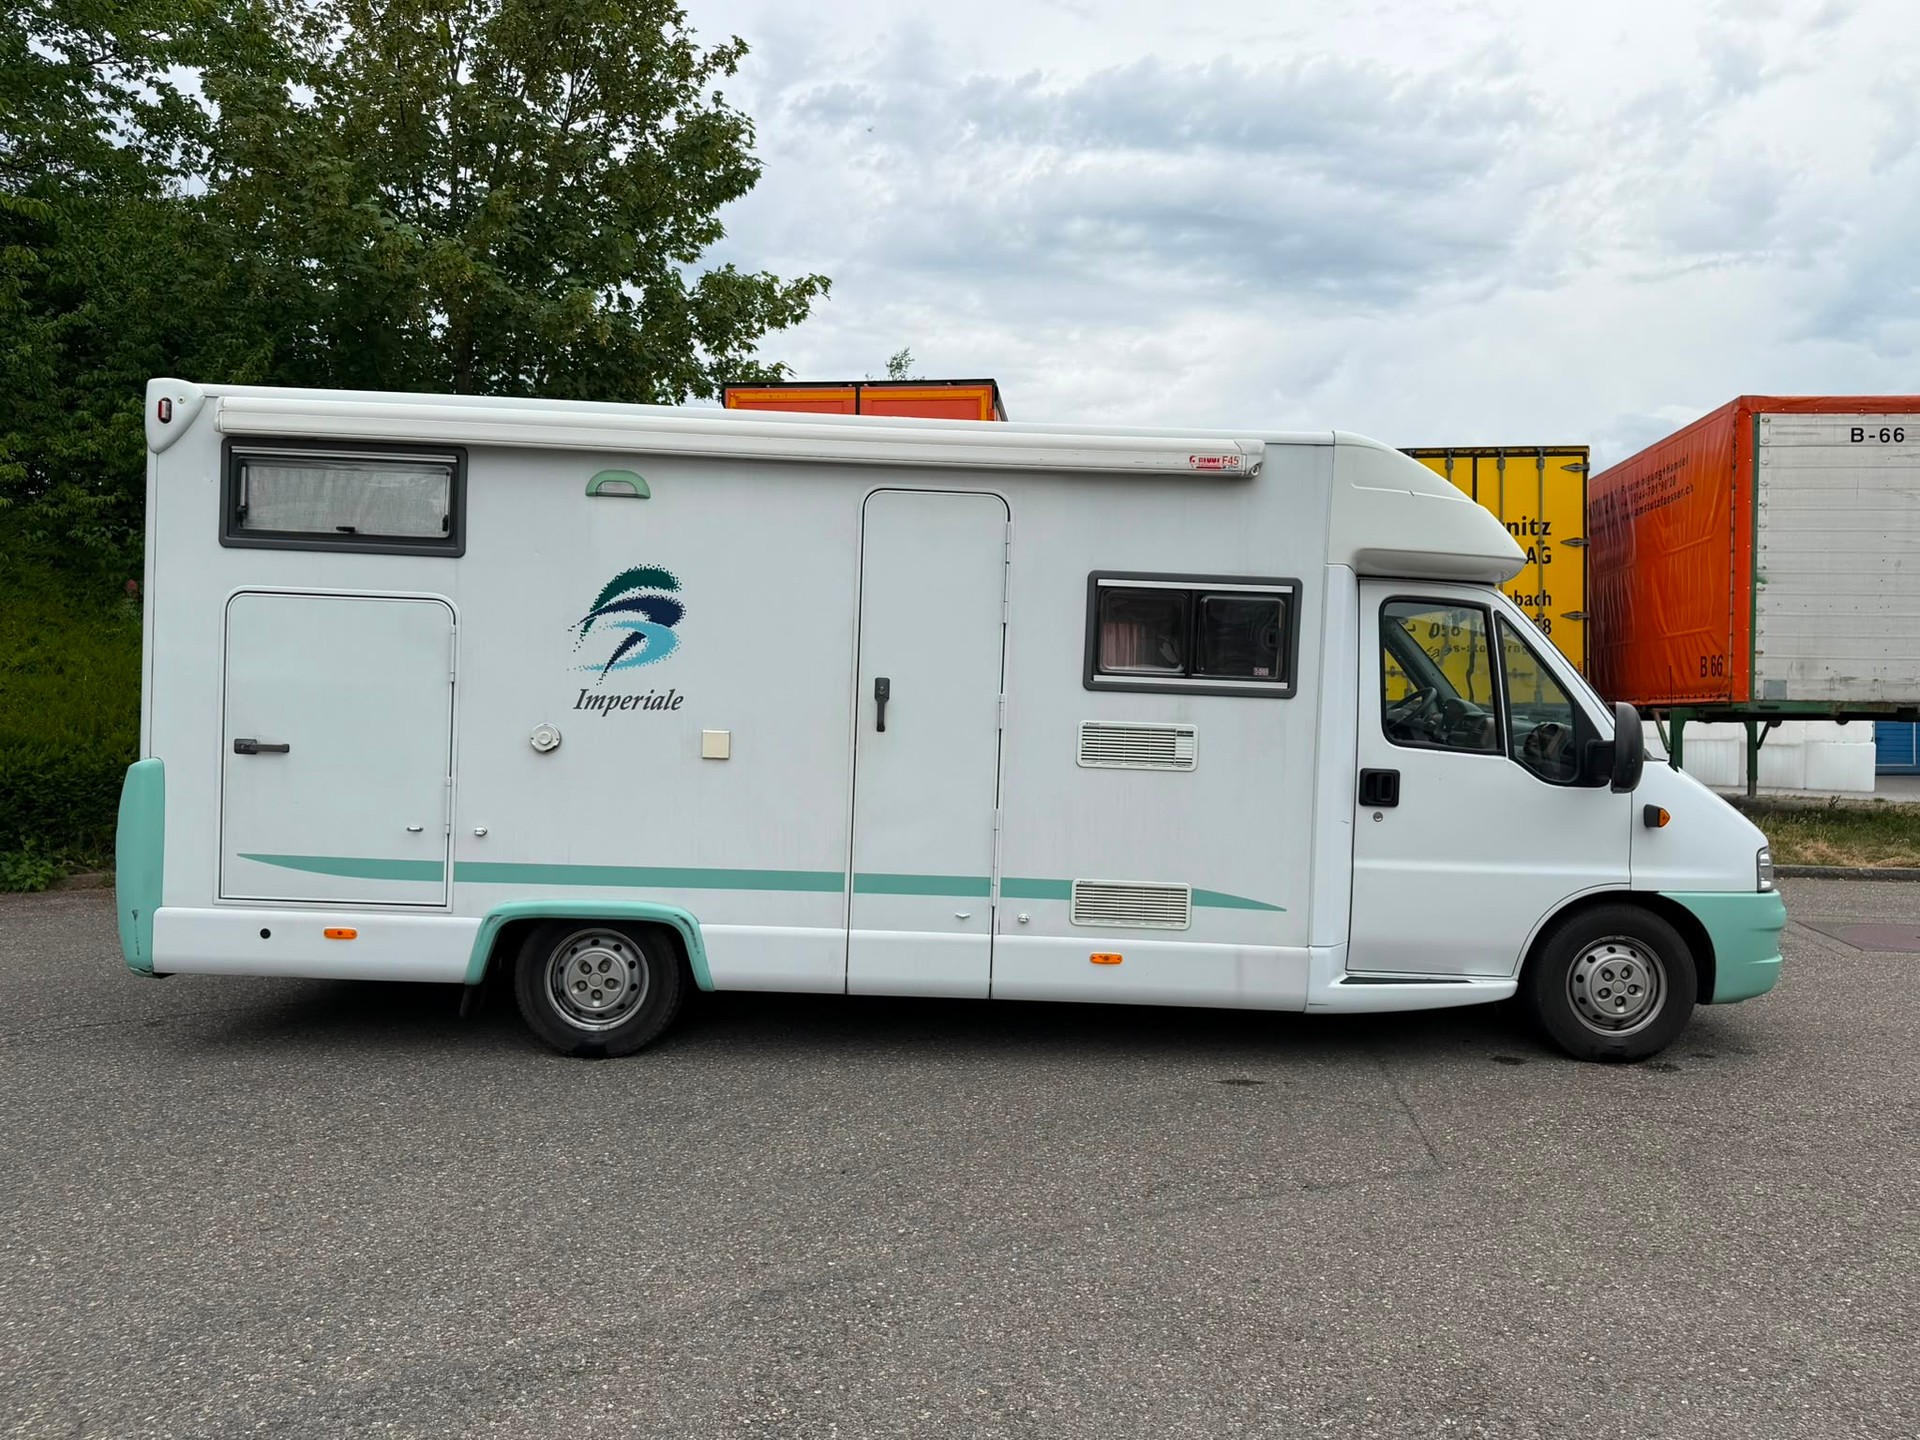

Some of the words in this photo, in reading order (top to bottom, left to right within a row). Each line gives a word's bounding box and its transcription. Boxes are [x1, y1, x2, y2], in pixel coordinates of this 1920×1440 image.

[1850, 427, 1905, 443] B-66
[1503, 515, 1552, 536] nitz
[1525, 546, 1552, 565] AG
[1507, 589, 1552, 607] bach
[1700, 655, 1708, 678] B
[1710, 653, 1724, 678] 66
[573, 688, 684, 717] Imperiale
